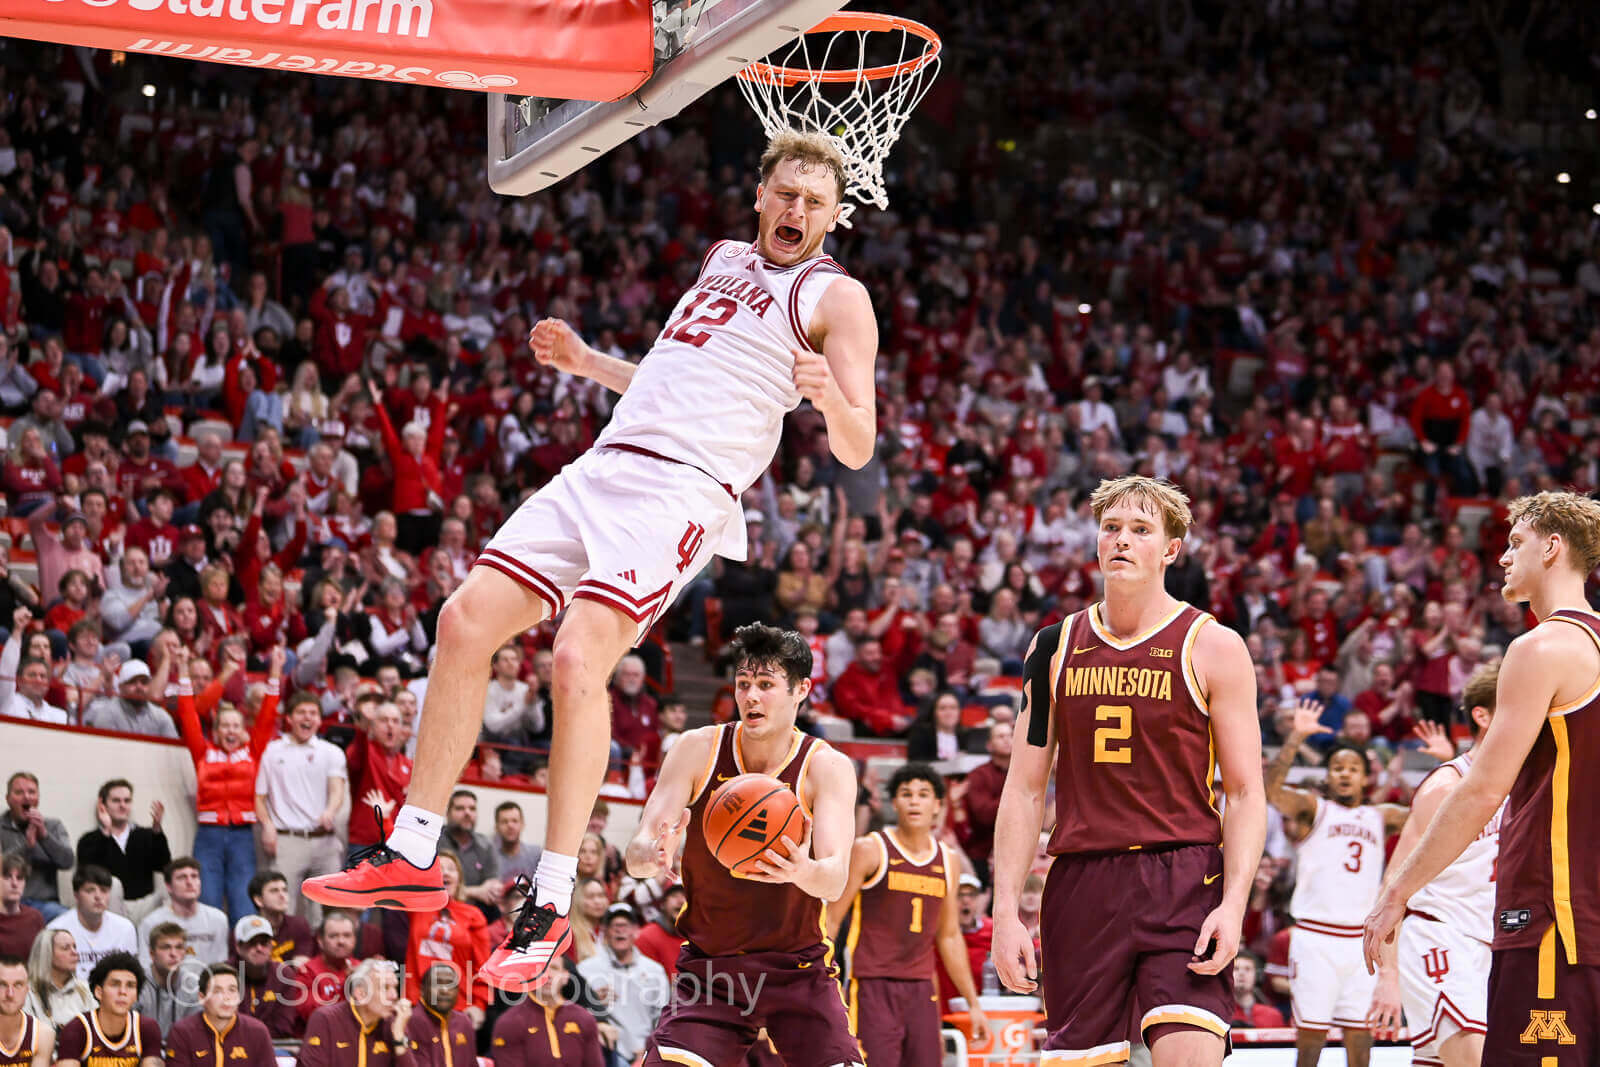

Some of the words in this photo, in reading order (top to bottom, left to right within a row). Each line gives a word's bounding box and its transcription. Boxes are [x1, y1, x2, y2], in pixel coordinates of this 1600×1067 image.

[128, 0, 433, 38] ateFarm
[126, 38, 432, 83] StateFarm
[662, 292, 737, 347] 12
[1065, 666, 1172, 701] MINNESOTA
[1093, 704, 1133, 764] 2
[1343, 840, 1363, 873] 3
[908, 897, 923, 933] 1
[1004, 1023, 1025, 1048] G
[1519, 1009, 1576, 1044] M
